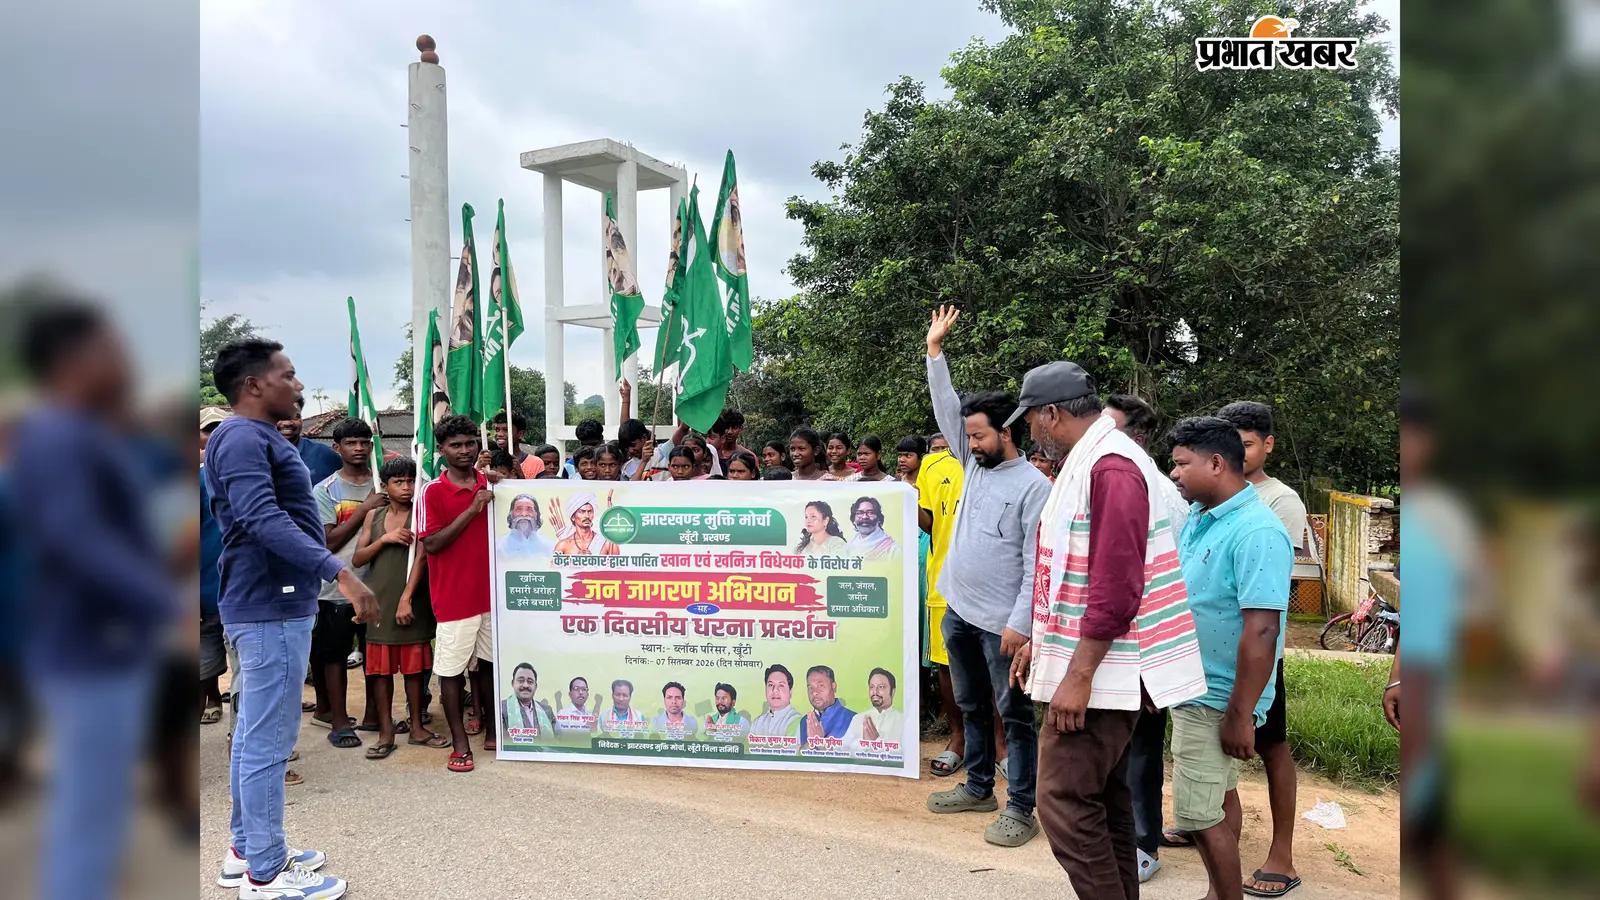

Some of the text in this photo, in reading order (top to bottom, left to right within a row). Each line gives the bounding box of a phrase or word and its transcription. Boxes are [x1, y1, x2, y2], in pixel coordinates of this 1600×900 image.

[640, 510, 772, 530] झारखण्ड मुक्ति मोर्चा
[679, 529, 731, 544] खूँटी प्रखण्ड
[553, 551, 863, 570] केंद्र सरकार द्वारा पारित खान एवं खनिज विधेयक के विरोध में
[519, 573, 545, 582] खनिज
[509, 584, 556, 596] हमारी धरोहर
[582, 575, 798, 604] जन जागरण अभियान
[517, 596, 529, 608] इसे
[847, 592, 868, 601] जमीन
[830, 604, 850, 613] हमारा
[852, 604, 880, 614] अधिकार
[560, 611, 836, 640] एक दिवसीय धरना प्रदर्शन
[673, 642, 698, 654] ब्लॉक
[732, 642, 752, 659] खूँटी
[668, 658, 693, 666] सितम्बर
[696, 659, 714, 667] 2026
[655, 742, 669, 752] मुक्ति
[702, 744, 718, 752] जिला
[719, 744, 740, 754] समिति
